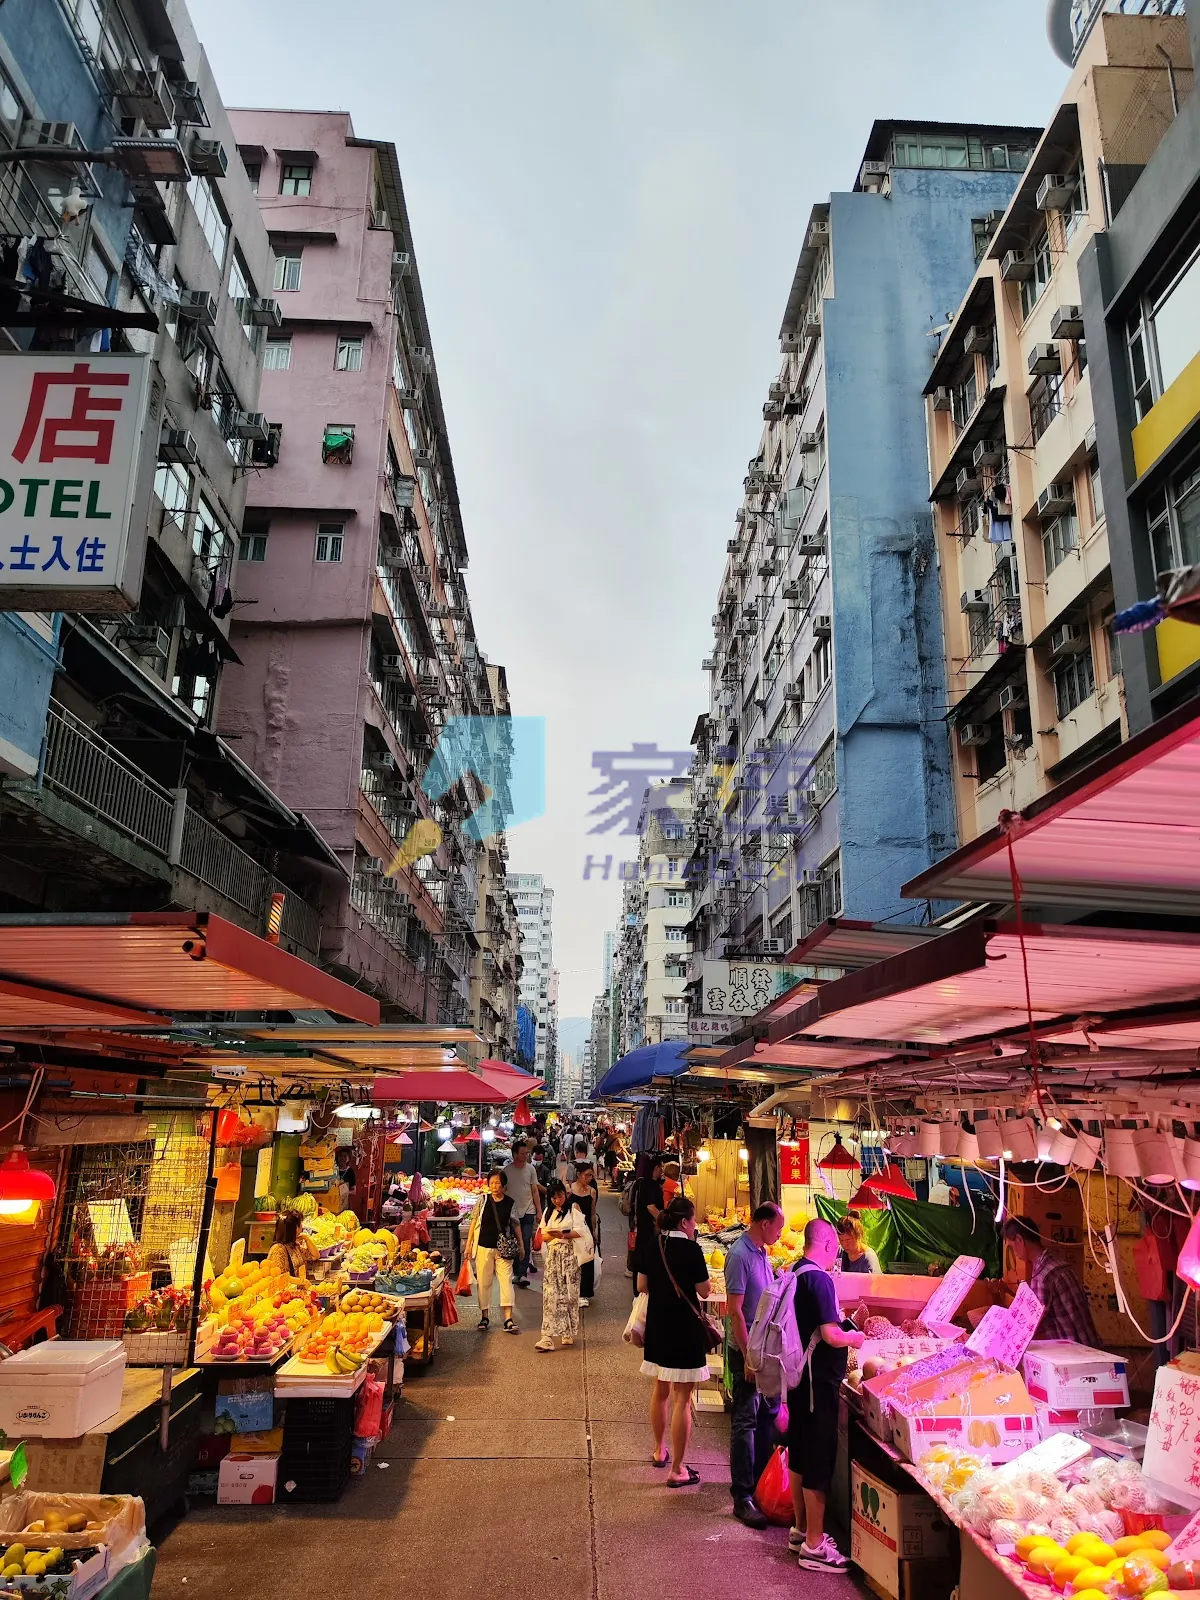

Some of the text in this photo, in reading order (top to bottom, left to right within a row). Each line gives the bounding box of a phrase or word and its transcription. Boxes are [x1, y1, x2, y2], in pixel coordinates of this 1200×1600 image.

[12, 363, 130, 465] 店
[0, 534, 107, 573] 士入住
[728, 967, 773, 991] 順發
[707, 987, 784, 1012] 雲吞專
